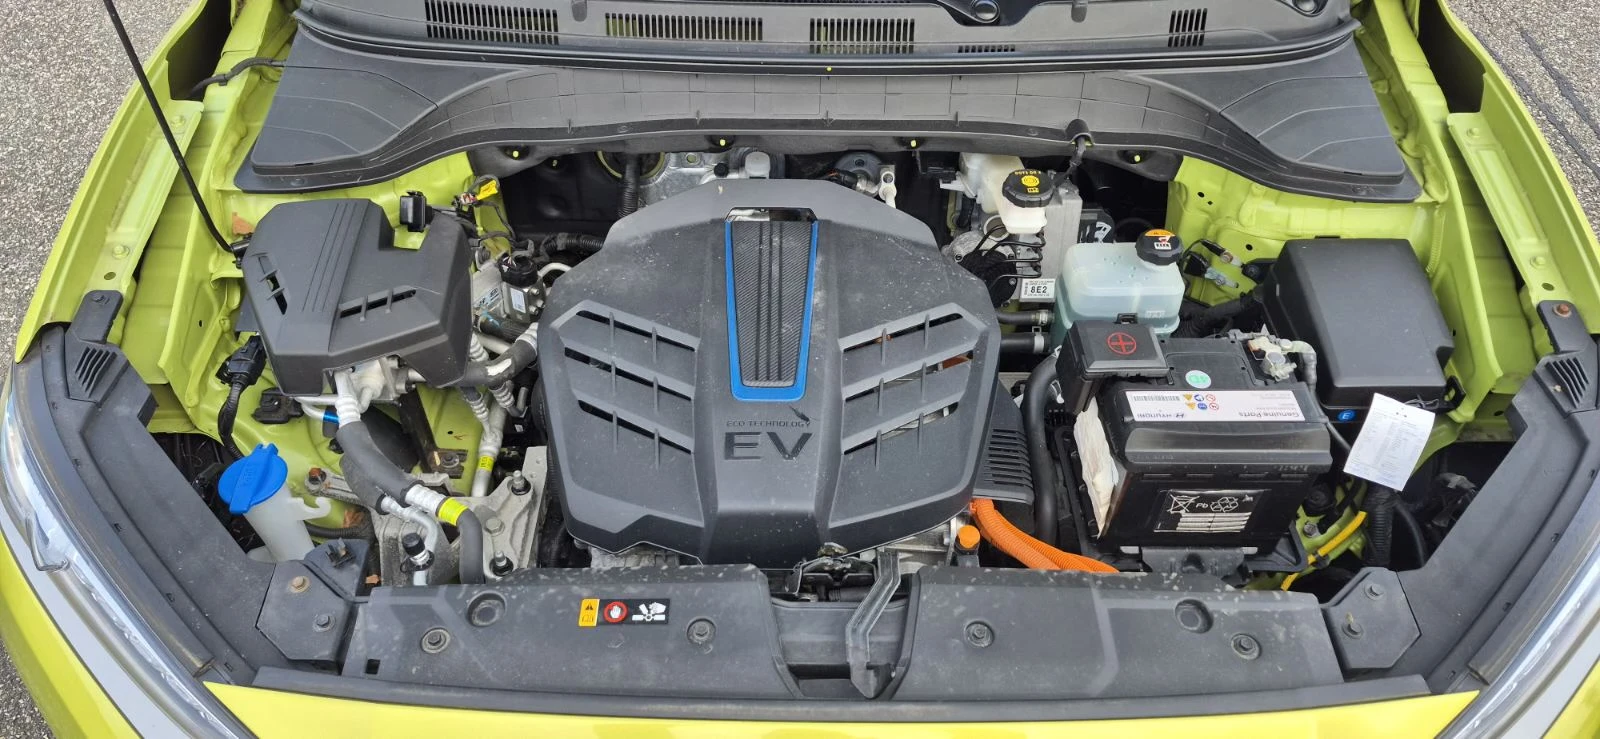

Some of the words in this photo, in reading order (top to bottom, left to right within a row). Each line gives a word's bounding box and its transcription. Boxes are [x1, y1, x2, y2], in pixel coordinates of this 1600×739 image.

[1030, 286, 1048, 294] 8E2
[1341, 412, 1351, 420] E
[726, 420, 746, 428] ECO
[748, 420, 811, 429] TECHNOLOGY
[724, 431, 813, 461] EV
